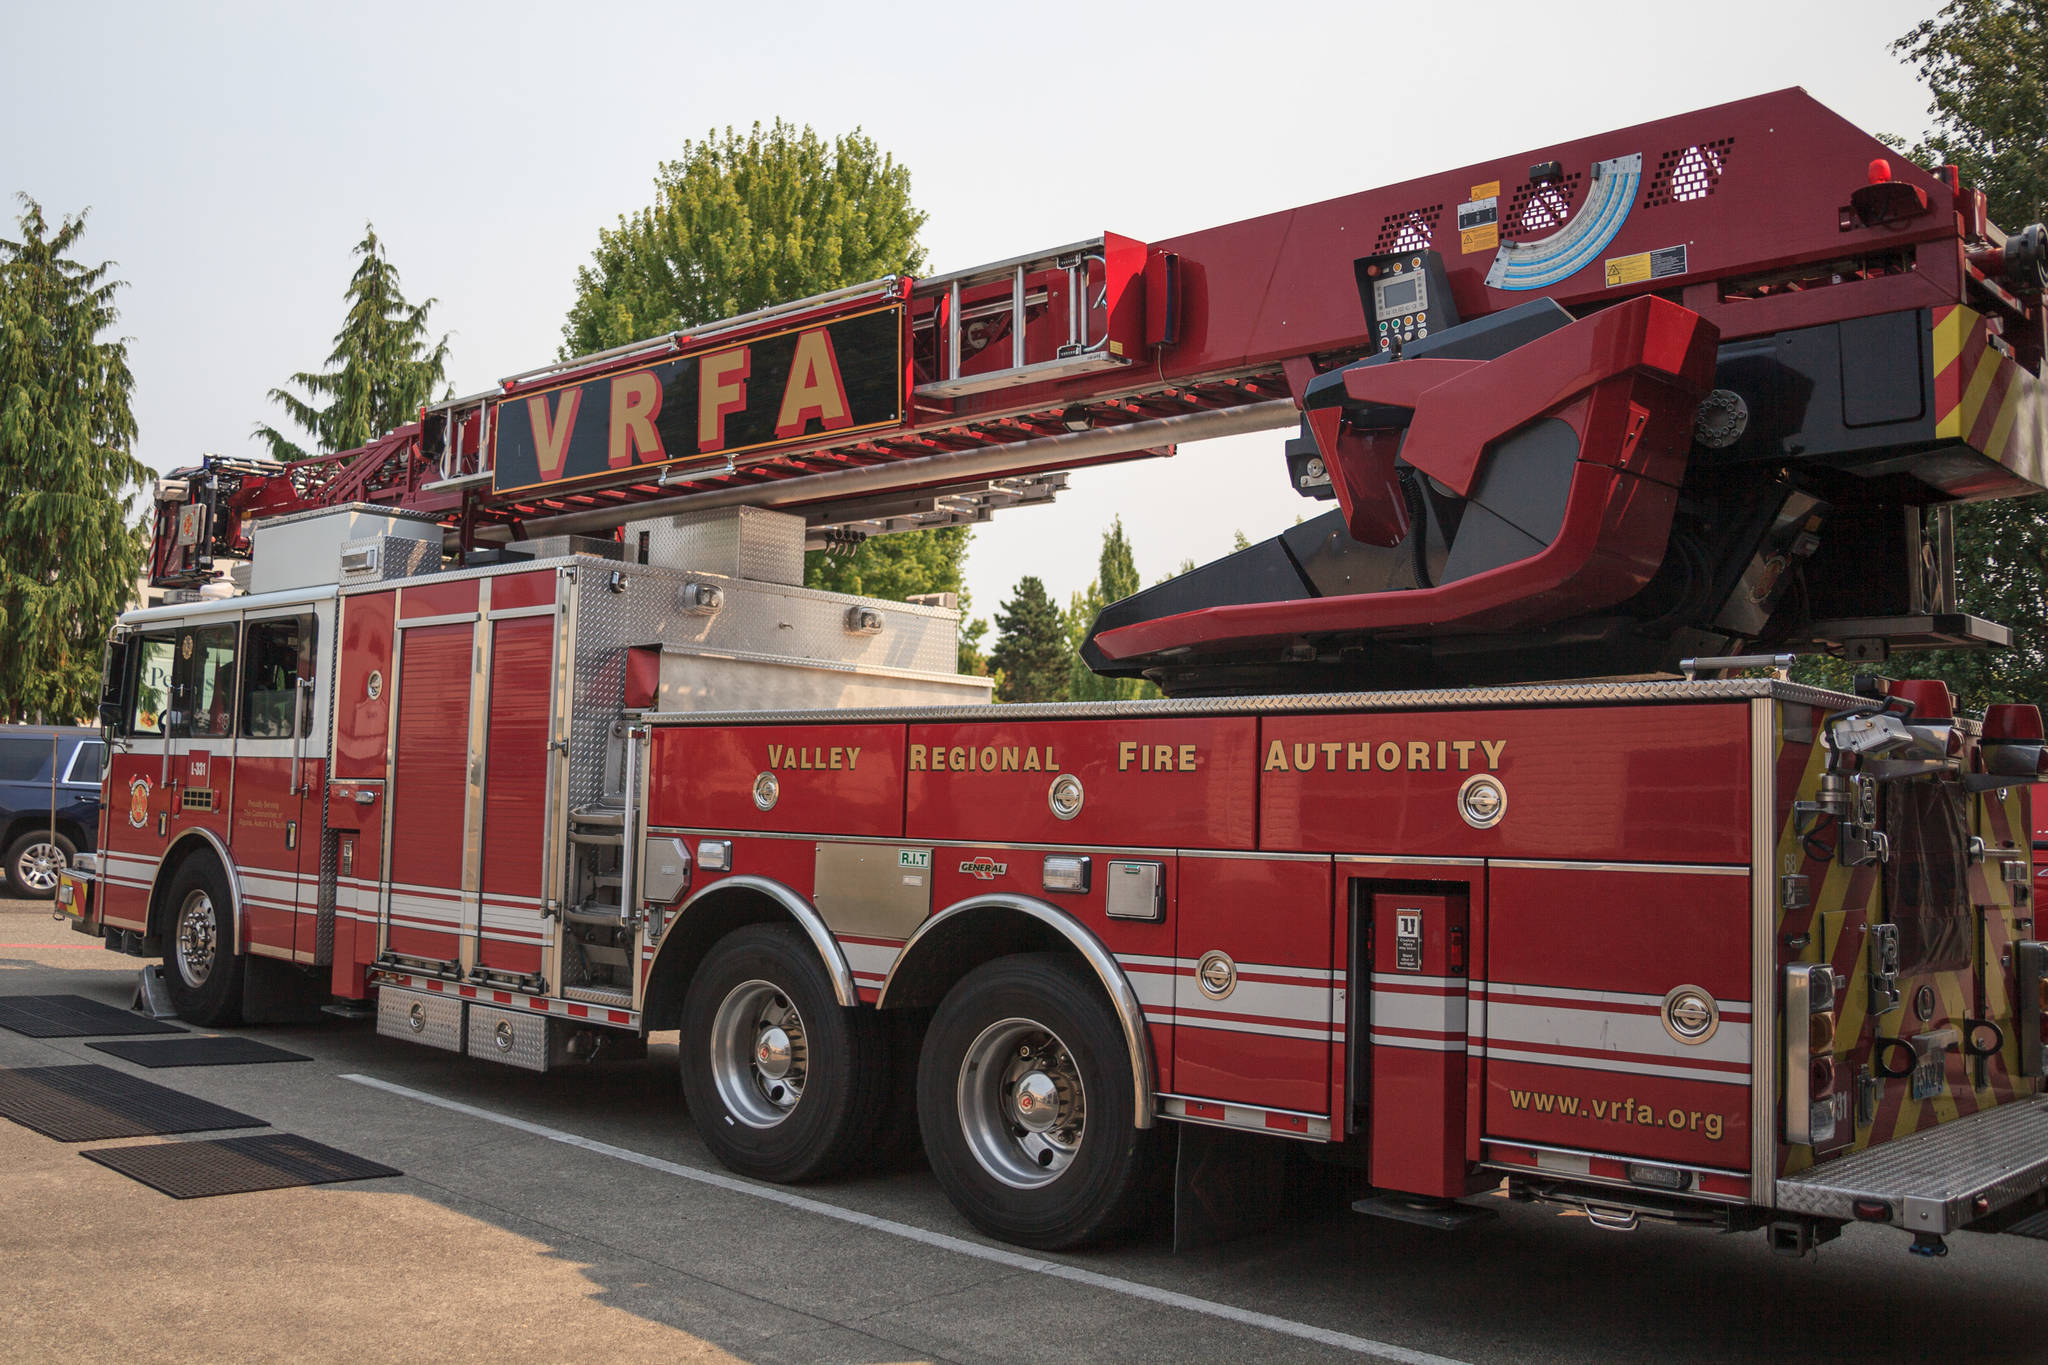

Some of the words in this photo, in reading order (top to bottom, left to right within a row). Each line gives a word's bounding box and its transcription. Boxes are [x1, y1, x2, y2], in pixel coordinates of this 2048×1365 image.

[526, 326, 855, 482] VRFA
[767, 744, 862, 771] VALLEY
[908, 744, 1060, 772] REGIONAL
[1119, 741, 1197, 772] FIRE
[1263, 739, 1507, 772] AUTHORITY
[901, 852, 927, 865] R.I.T
[961, 862, 1004, 873] GENERAL
[1509, 1089, 1724, 1140] www.vrfa.org
